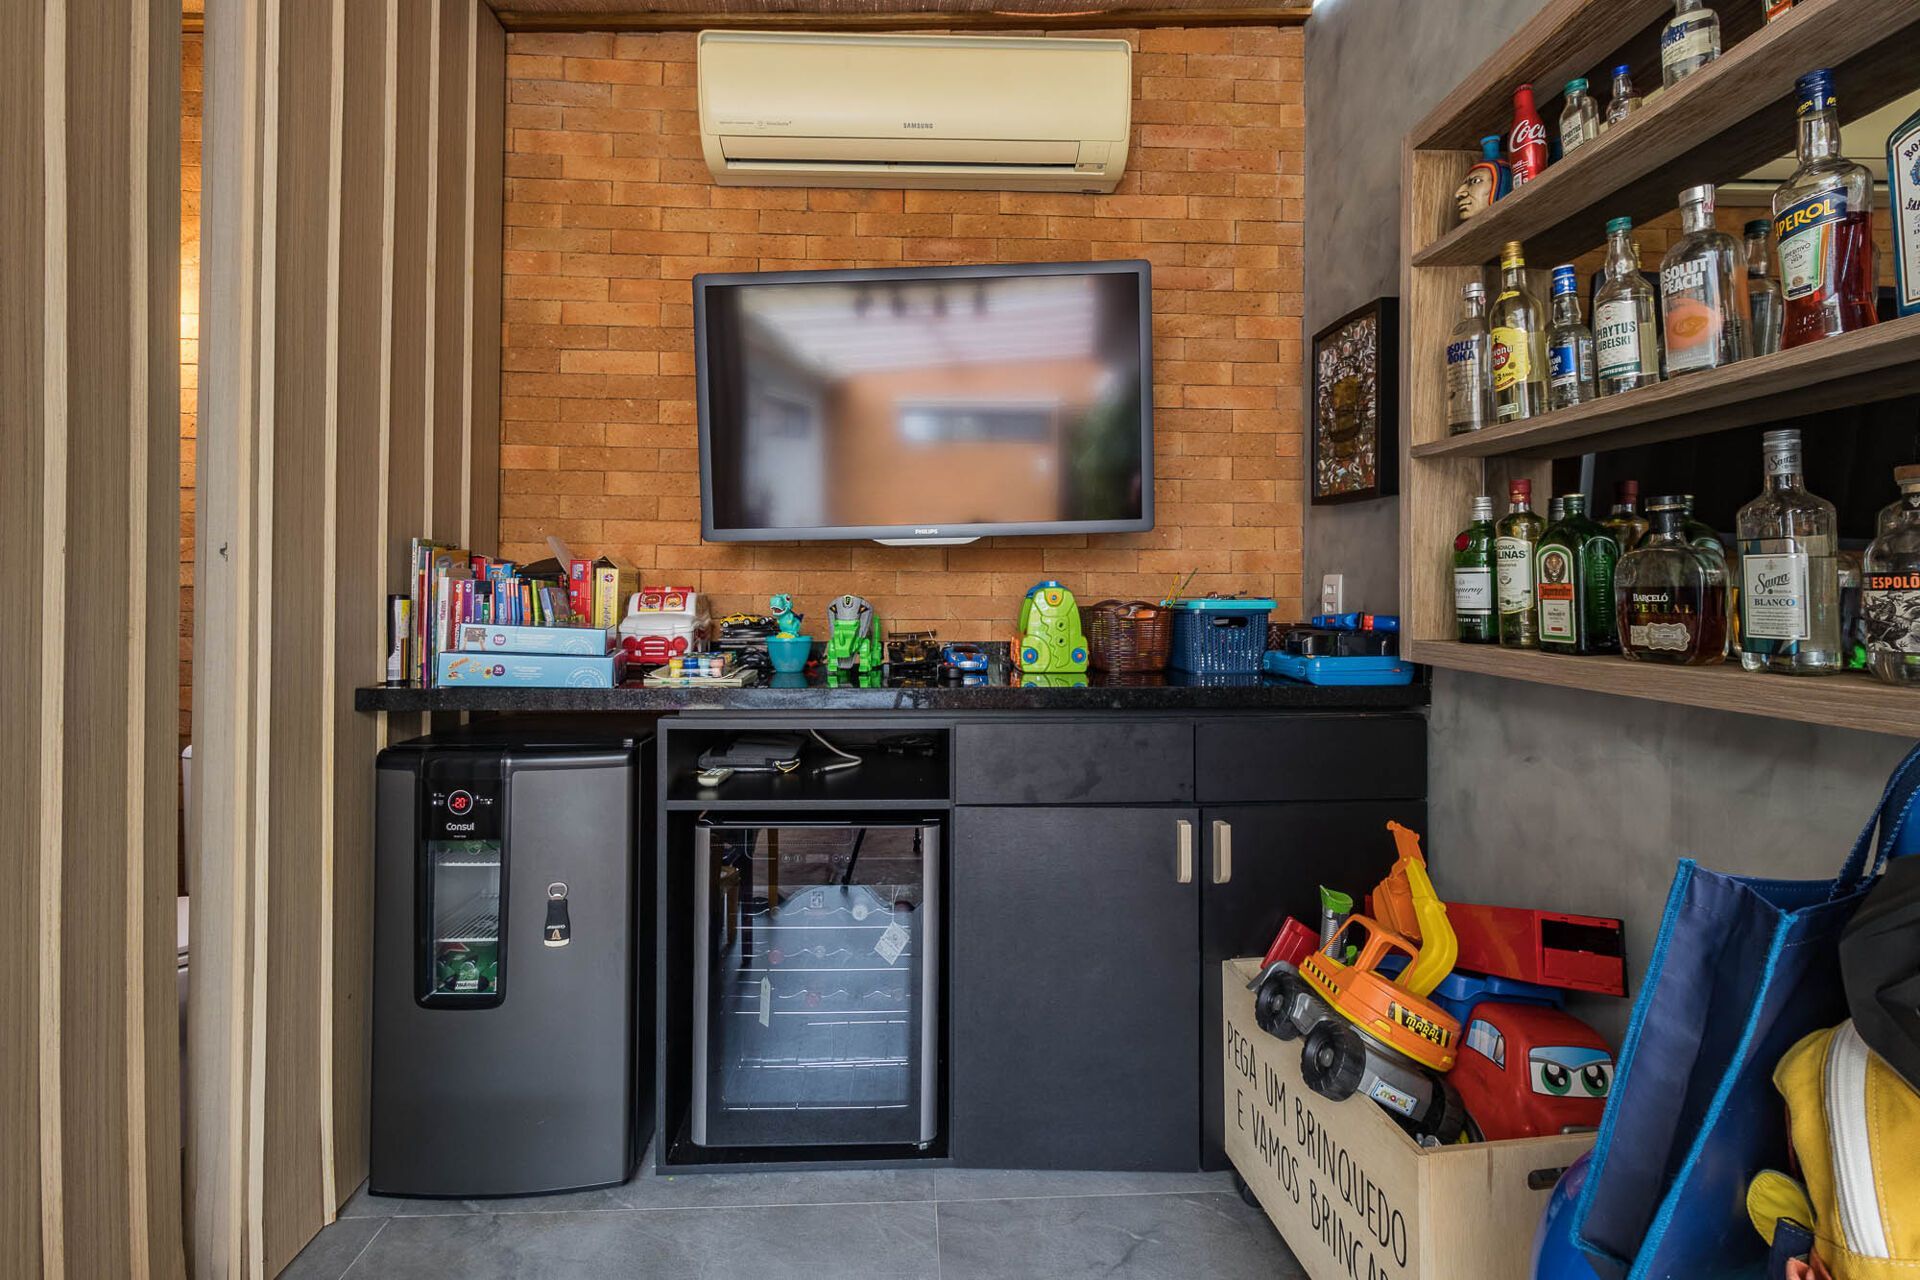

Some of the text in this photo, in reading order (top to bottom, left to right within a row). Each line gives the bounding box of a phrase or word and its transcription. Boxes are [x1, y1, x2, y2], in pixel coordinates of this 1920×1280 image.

[903, 122, 934, 130] SAMSUNG
[1903, 138, 1920, 161] BO
[1661, 259, 1709, 285] SOLUT
[1663, 271, 1704, 298] PEACH
[1768, 453, 1799, 471] Sauza
[1498, 550, 1527, 560] LINAS
[1754, 573, 1791, 595] Sauza
[1633, 592, 1669, 602] BARCELÓ
[1754, 598, 1795, 606] BLANCO
[446, 822, 475, 831] Consul
[1406, 1016, 1440, 1040] MARAL
[1227, 1020, 1407, 1268] PEGA UM BRINQUEDO
[1237, 1089, 1388, 1280] E VAMOS BRINCA
